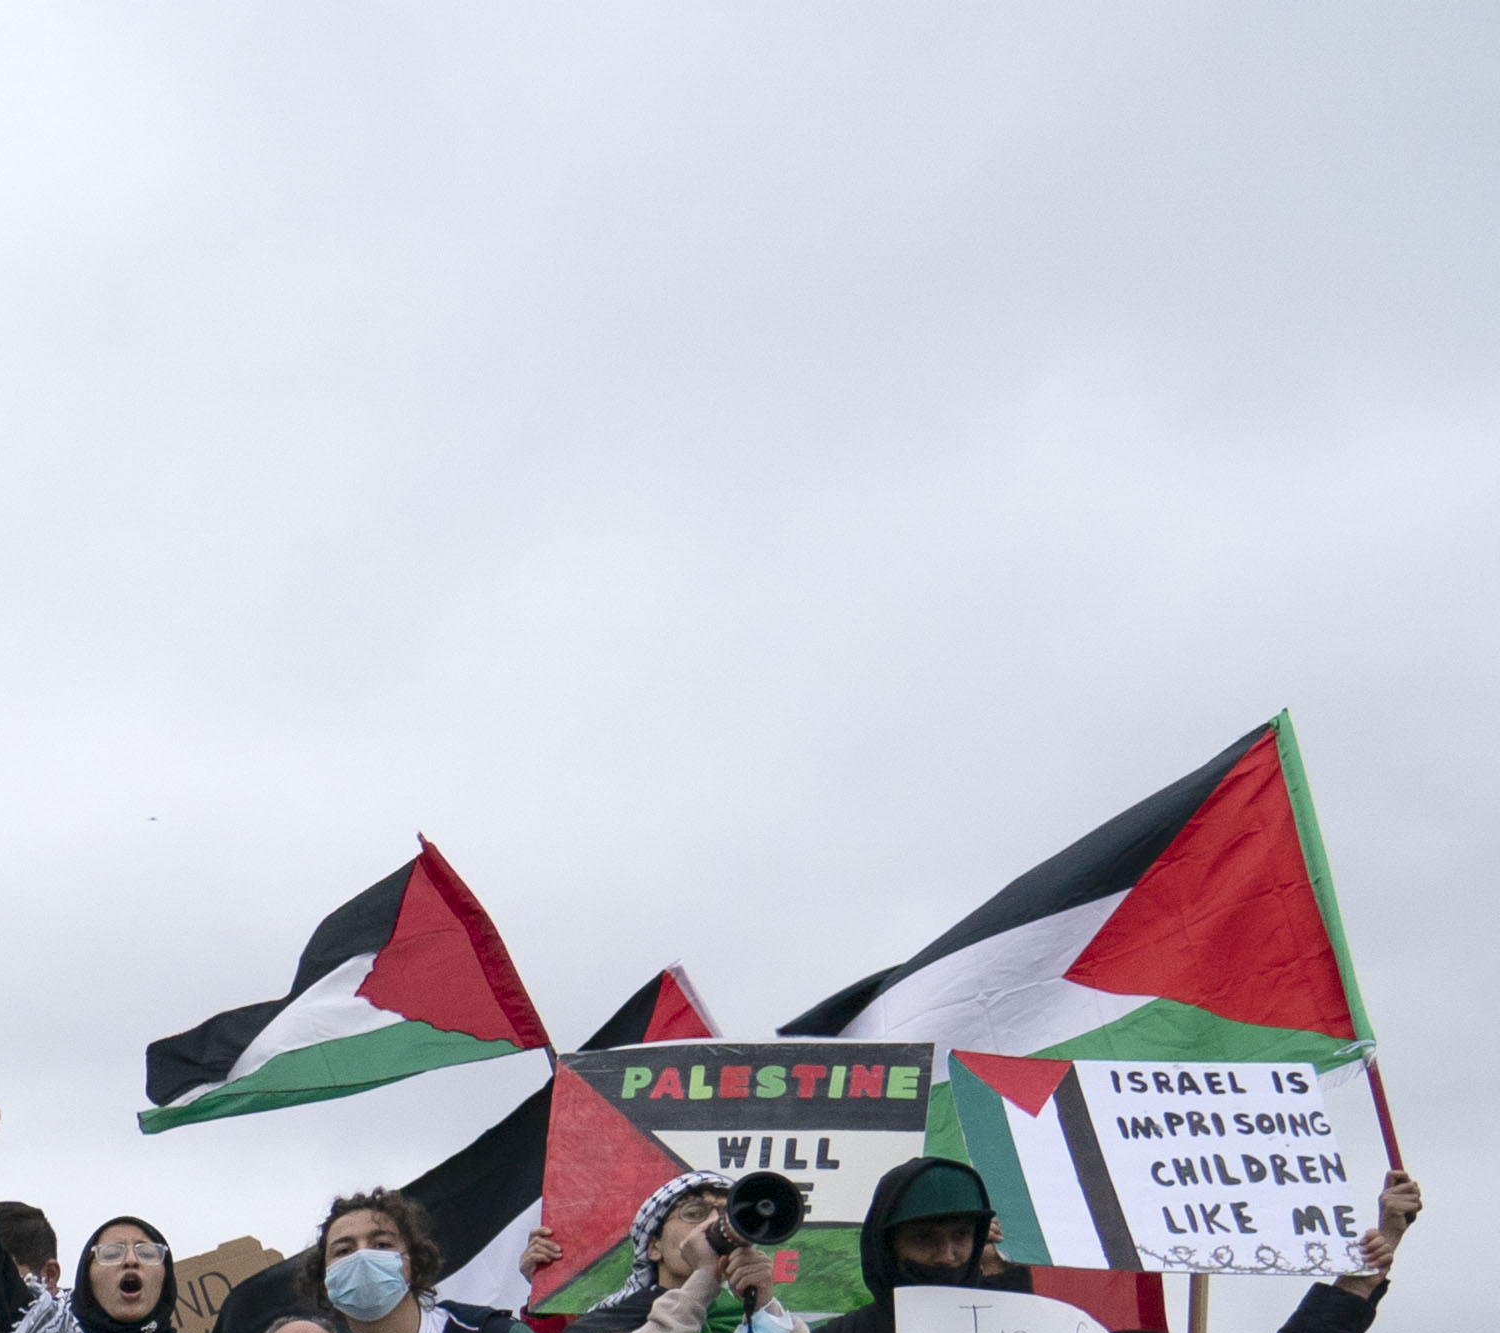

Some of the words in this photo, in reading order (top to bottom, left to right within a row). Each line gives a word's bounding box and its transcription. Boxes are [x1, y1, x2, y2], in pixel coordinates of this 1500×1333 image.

[621, 1065, 921, 1100] PALESTINE
[1110, 1071, 1247, 1095] ISRAEL
[1272, 1071, 1309, 1094] IS
[718, 1136, 840, 1169] WILL
[1151, 1153, 1347, 1187] CHILDREN
[1162, 1202, 1258, 1235] LIKE
[1292, 1205, 1358, 1238] ME
